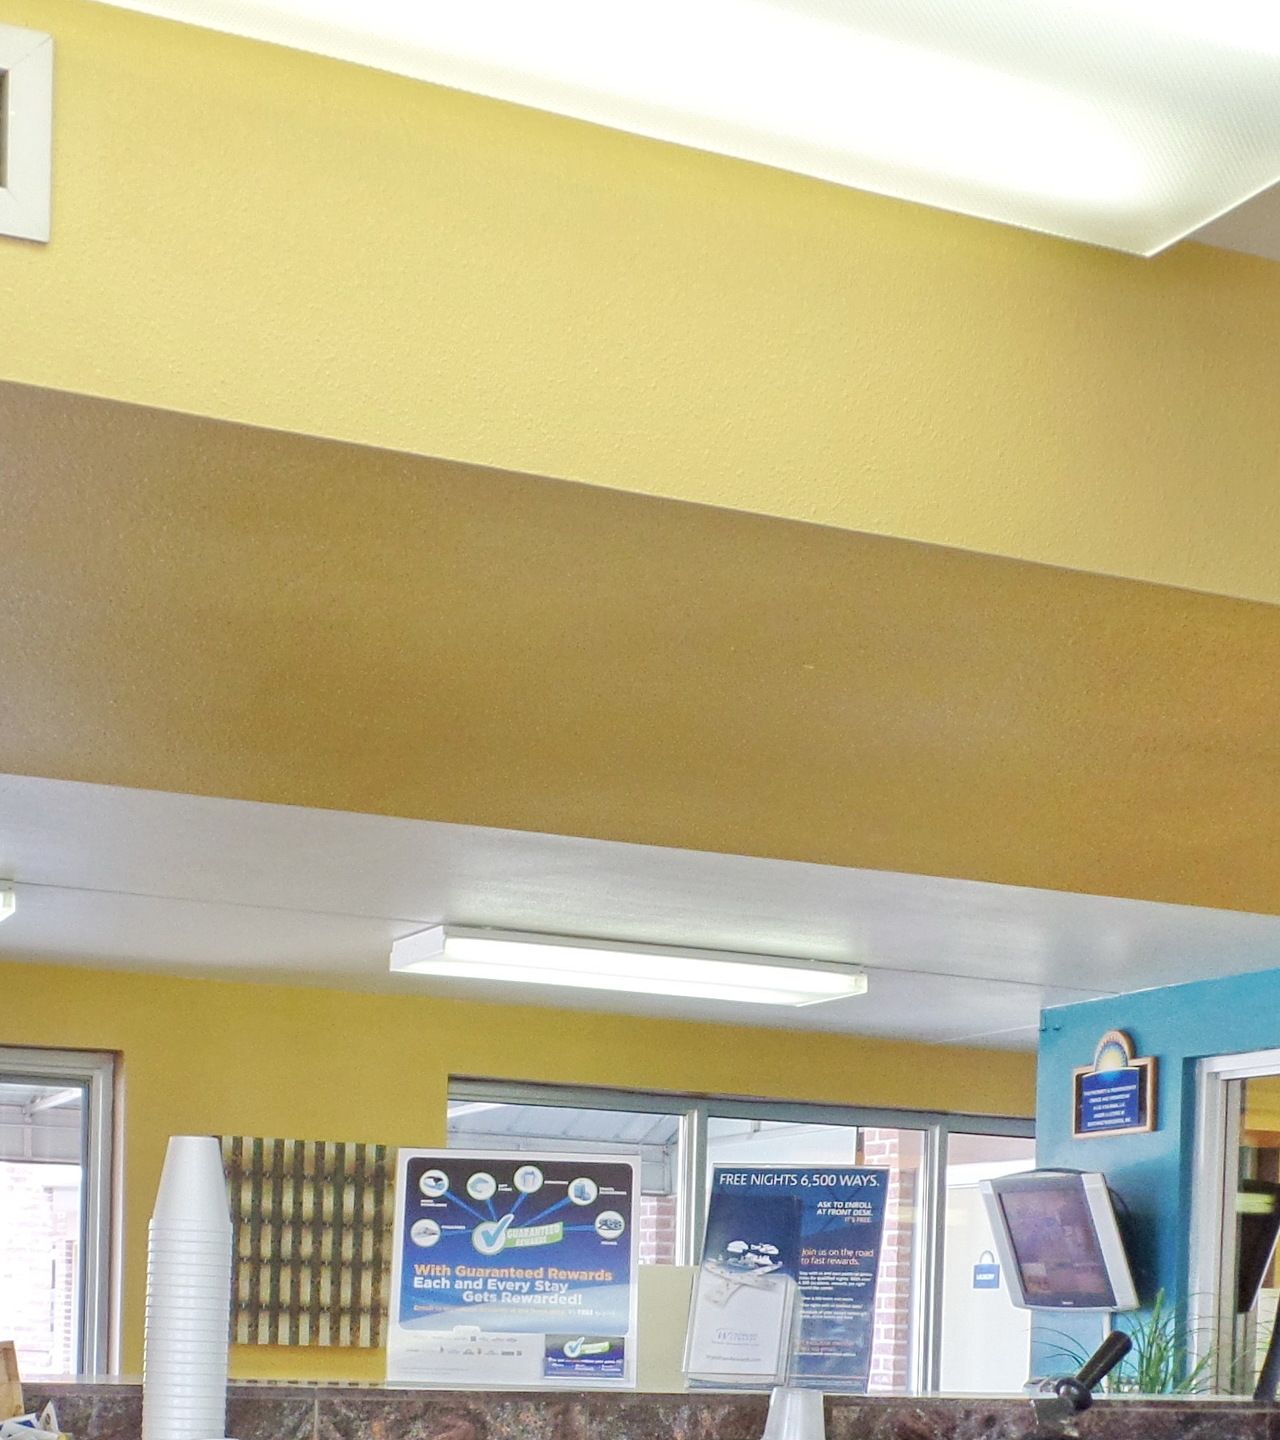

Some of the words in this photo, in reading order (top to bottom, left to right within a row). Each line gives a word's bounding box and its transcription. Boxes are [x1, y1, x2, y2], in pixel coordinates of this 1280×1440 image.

[720, 1173, 748, 1186] FREE
[750, 1173, 798, 1186] NIGHTS
[800, 1174, 837, 1188] 6,500
[839, 1174, 880, 1187] WAYS.
[817, 1201, 831, 1209] ASK
[833, 1201, 844, 1209] TO
[845, 1201, 872, 1209] ENROLL
[828, 1209, 851, 1217] FRONT
[506, 1222, 561, 1239] GUARANTEED
[800, 1248, 817, 1257] Join
[840, 1248, 853, 1258] the
[855, 1249, 874, 1258] road
[801, 1257, 809, 1265] to
[810, 1257, 825, 1266] fast
[827, 1257, 861, 1266] rewards.
[414, 1264, 451, 1276] With
[455, 1265, 543, 1279] Guaranteed
[547, 1267, 613, 1281] Rewards
[413, 1277, 451, 1289] Each
[454, 1278, 483, 1290] and
[487, 1279, 531, 1293] Every
[534, 1280, 569, 1294] Stay
[462, 1291, 497, 1303] Gets
[501, 1292, 583, 1305] Rewarded!
